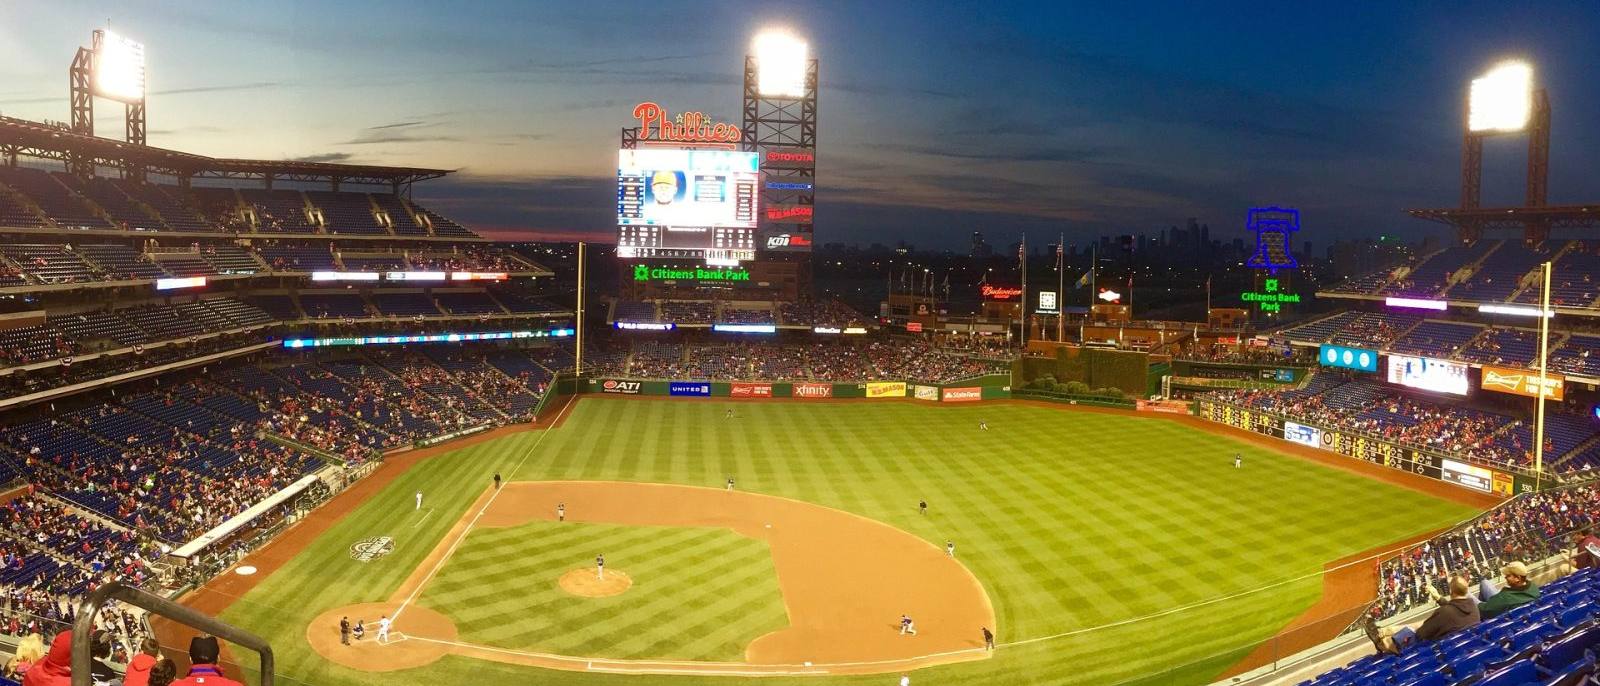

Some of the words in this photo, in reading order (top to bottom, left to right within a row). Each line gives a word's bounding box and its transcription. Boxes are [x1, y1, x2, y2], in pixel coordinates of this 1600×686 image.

[632, 102, 741, 142] Phillies
[780, 153, 813, 161] TOYOTA
[651, 269, 694, 279] Citizens
[696, 270, 723, 279] Bank
[725, 271, 750, 280] Park
[982, 284, 1021, 295] Budweiser
[1241, 292, 1276, 301] Citizens
[1278, 294, 1300, 302] Bank
[1261, 302, 1280, 311] Park
[616, 382, 640, 390] ATI
[796, 384, 830, 396] xfinity
[1521, 484, 1533, 492] 330
